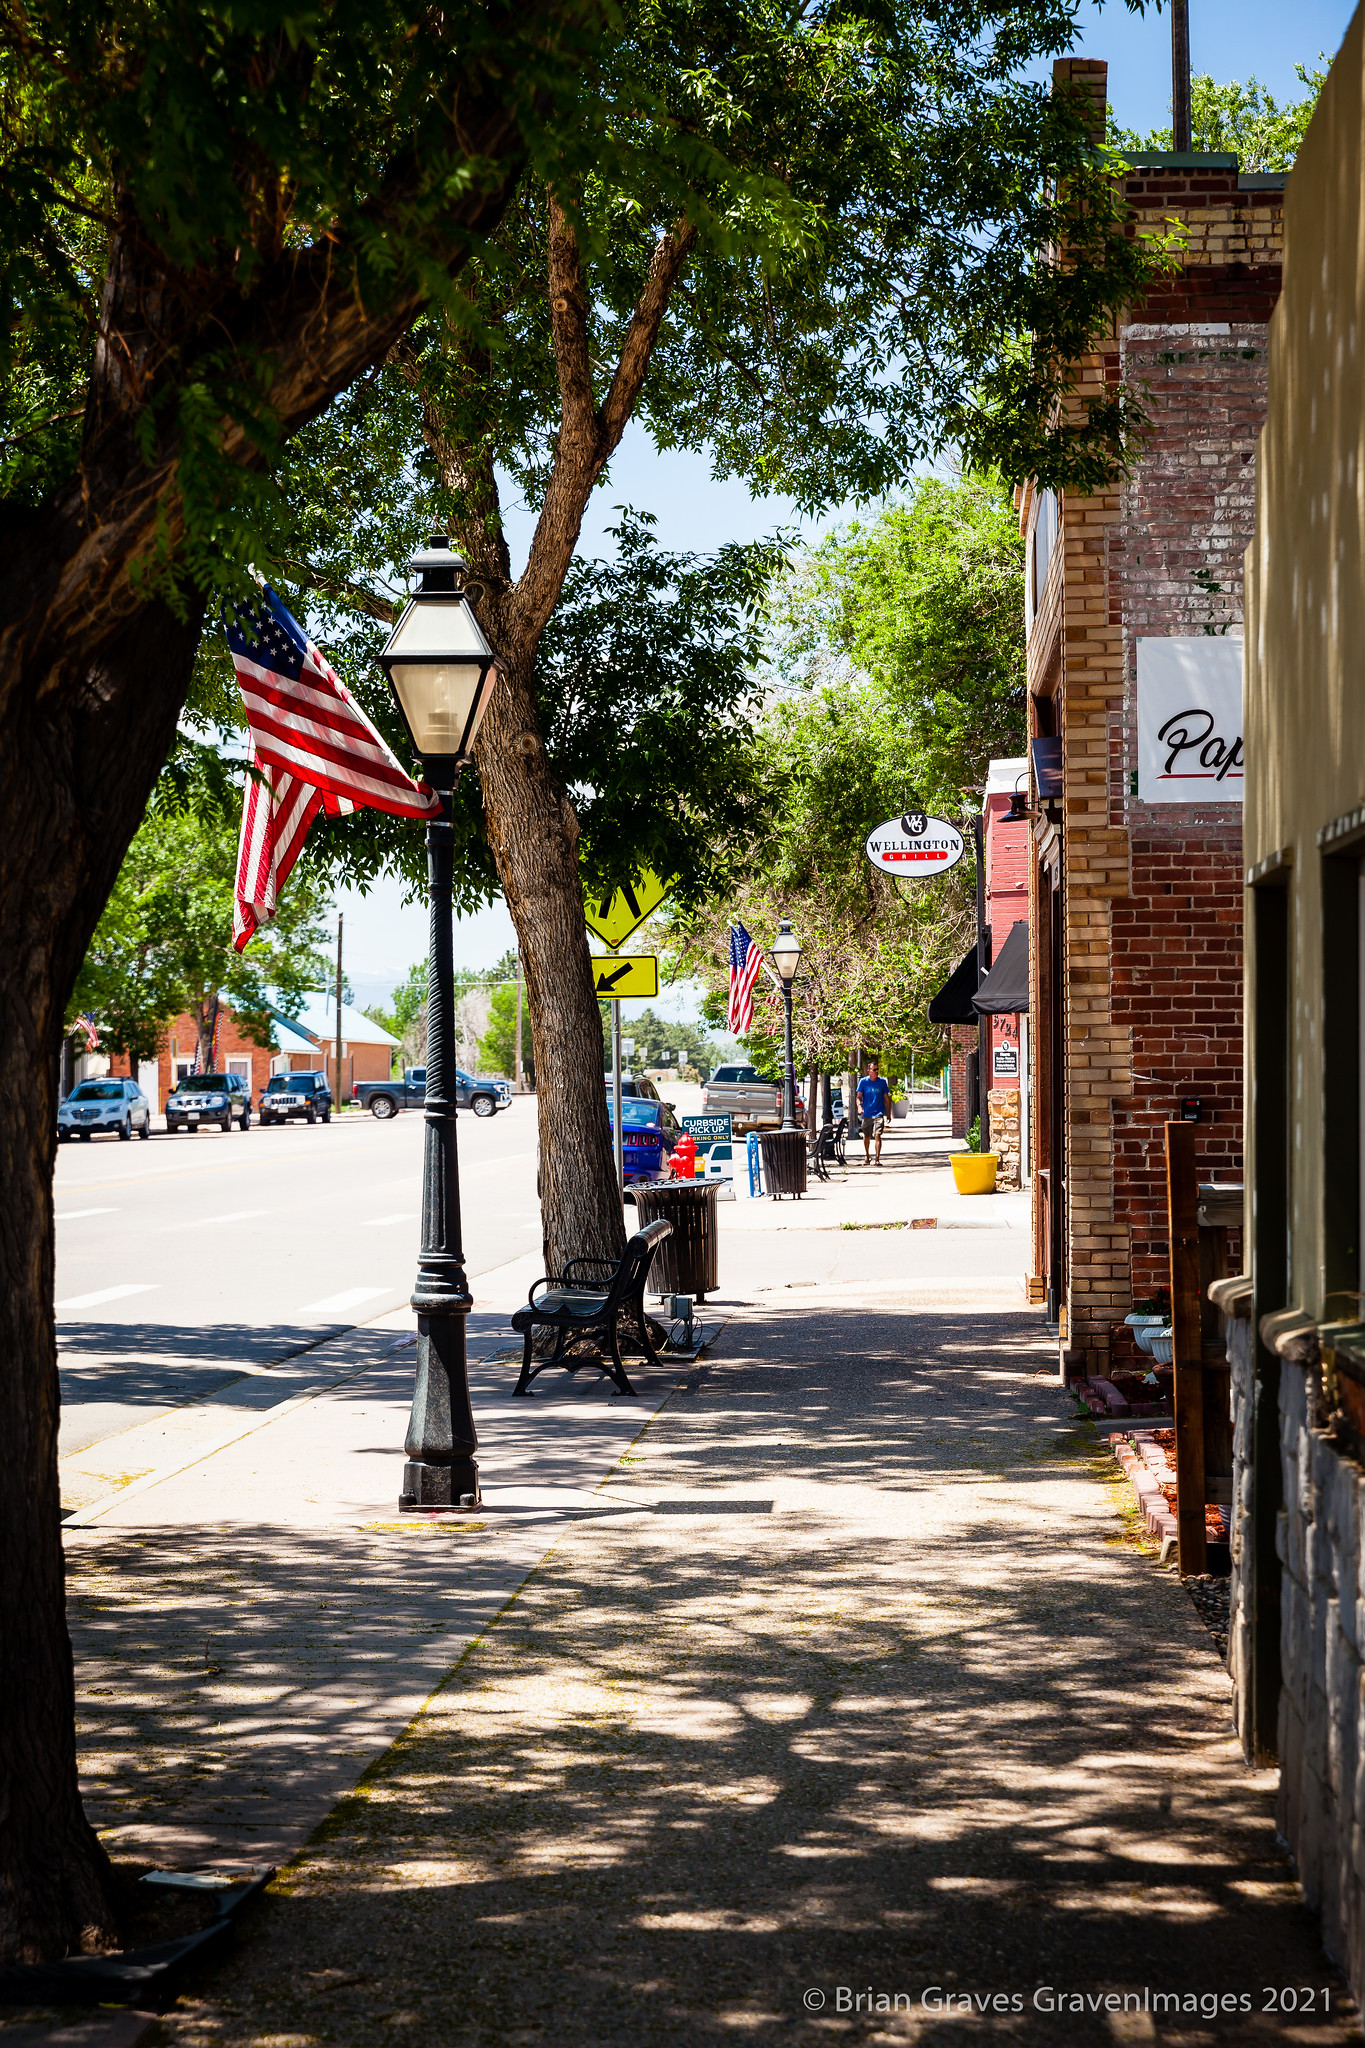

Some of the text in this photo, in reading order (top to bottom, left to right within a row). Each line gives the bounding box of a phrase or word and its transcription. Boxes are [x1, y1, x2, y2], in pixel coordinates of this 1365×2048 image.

[905, 815, 922, 833] WG
[869, 839, 960, 853] WELLINGTON
[993, 1014, 1017, 1039] 3724
[683, 1118, 729, 1127] CURBSIDE
